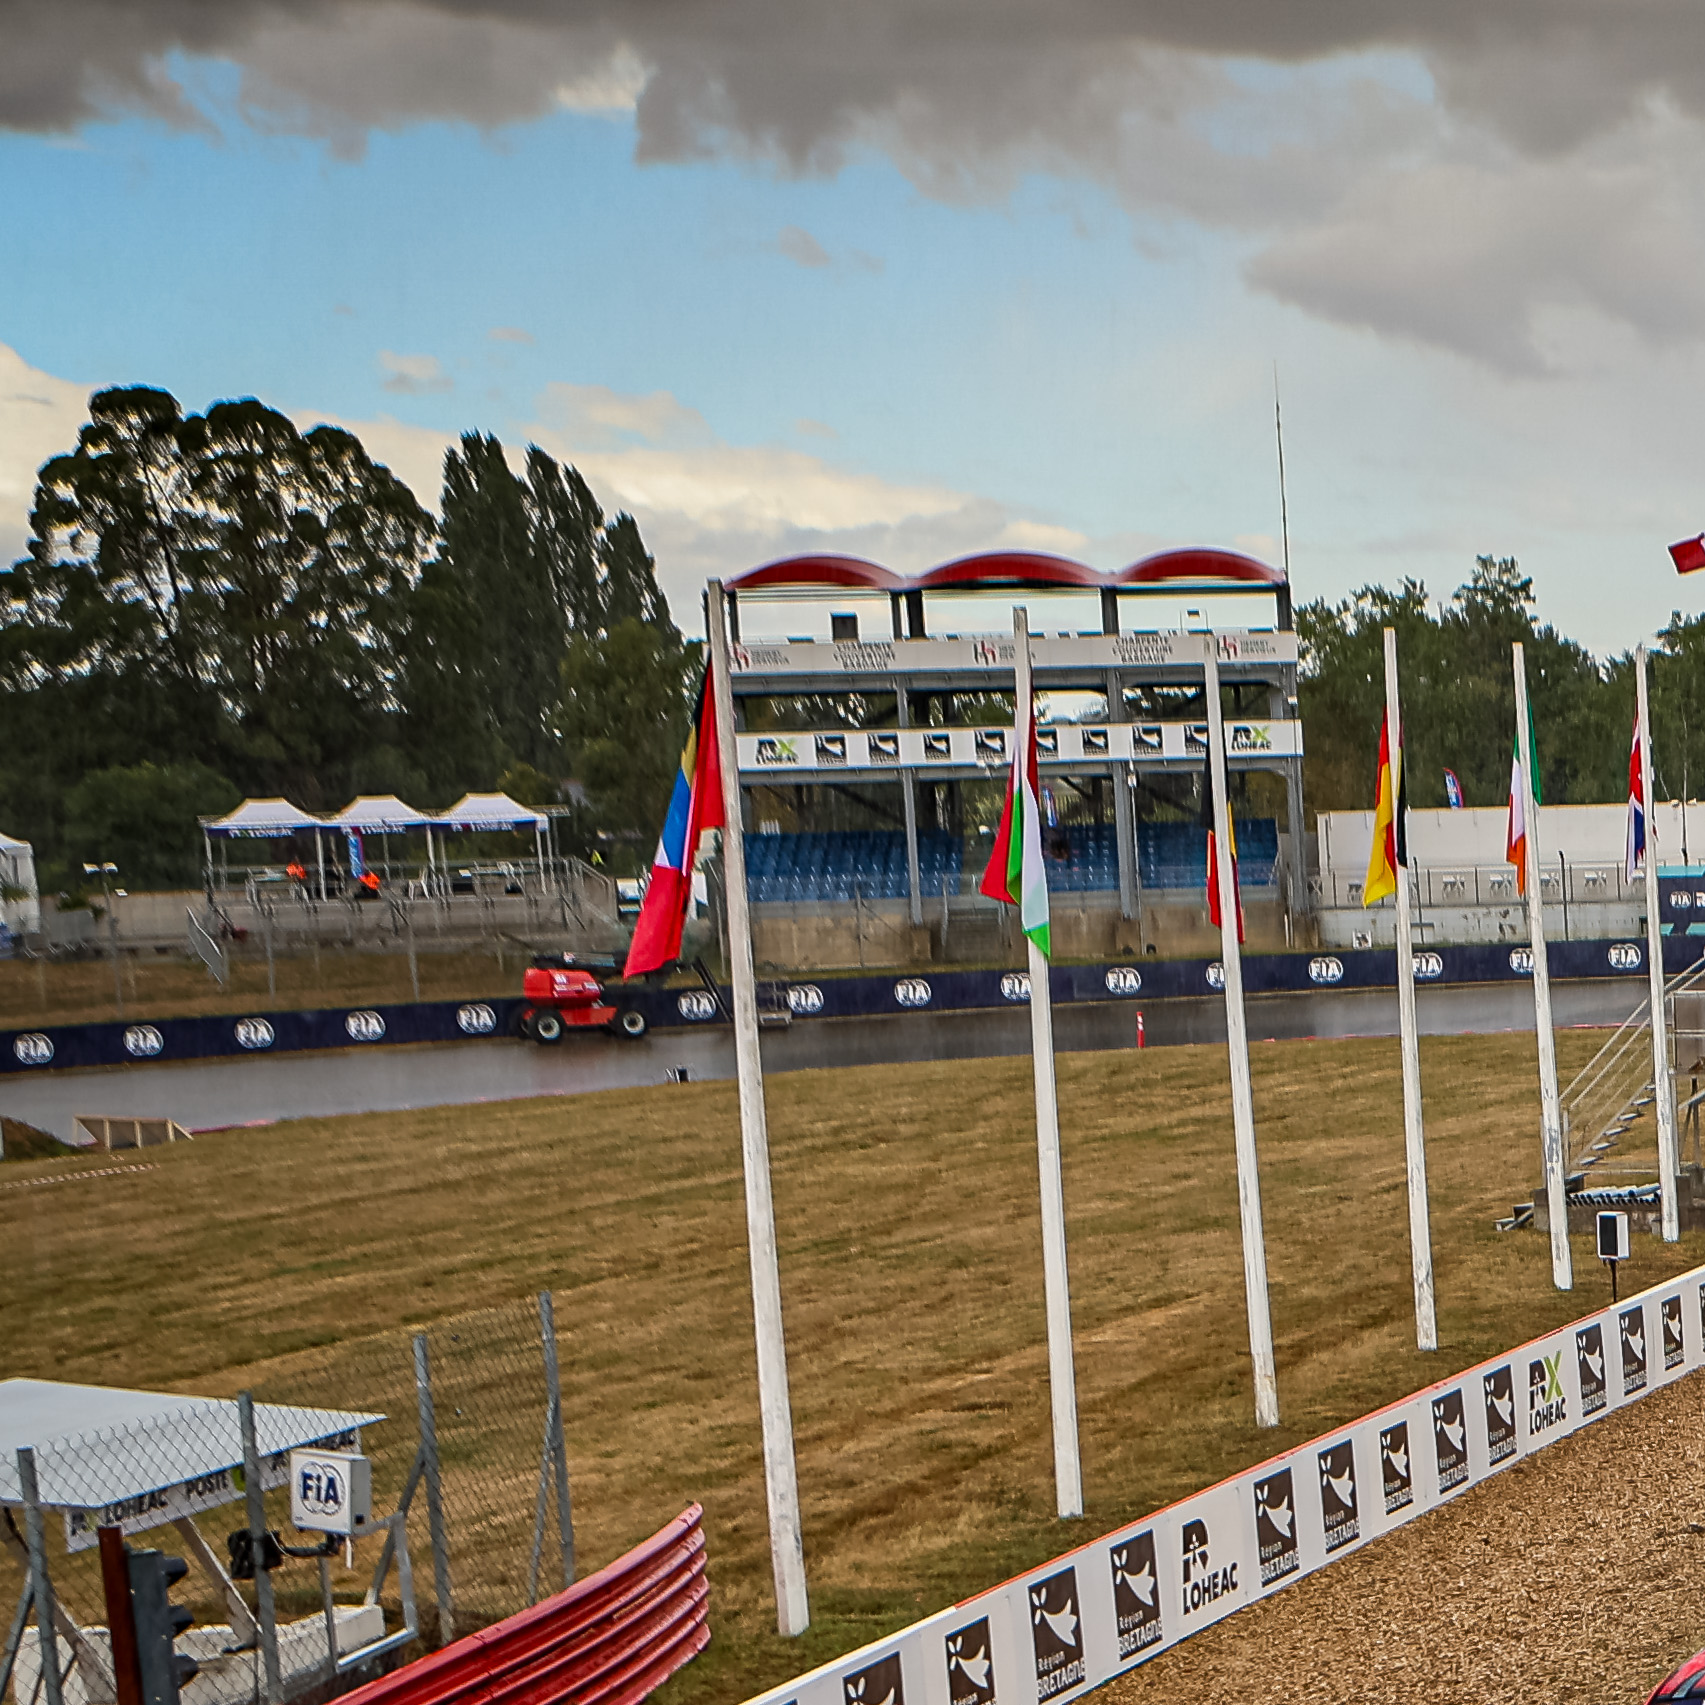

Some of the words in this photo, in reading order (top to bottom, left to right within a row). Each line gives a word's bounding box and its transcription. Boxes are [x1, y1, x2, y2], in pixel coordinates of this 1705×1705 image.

[896, 981, 931, 1003] FIA
[1107, 971, 1141, 991] FIA
[787, 987, 823, 1010] FIA
[1529, 1396, 1568, 1435] LOHEAC
[301, 1472, 341, 1505] FIA
[1260, 1550, 1299, 1583] BRETAGNE
[1183, 1563, 1239, 1615] LOHEAC
[1118, 1617, 1163, 1657] BRETAGNE
[1037, 1657, 1087, 1700] BRETAGNE
